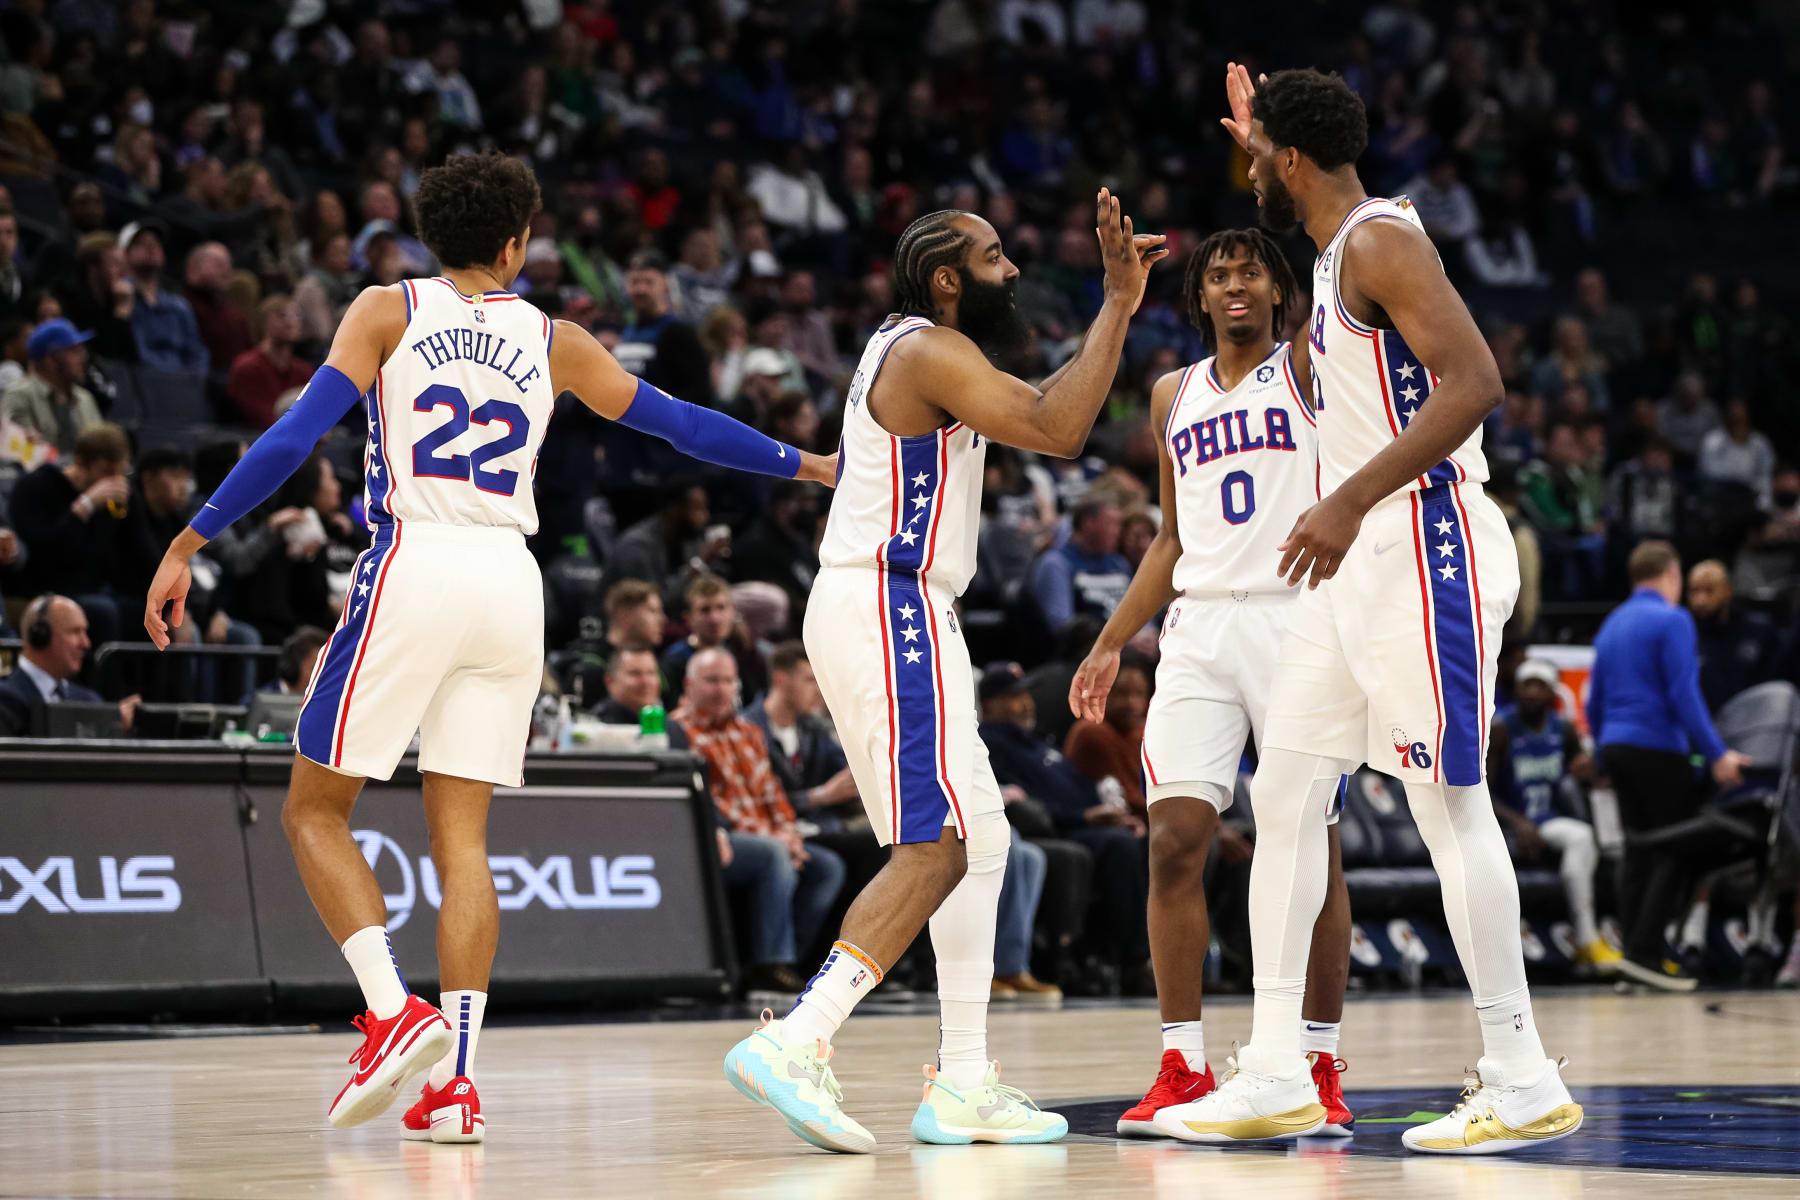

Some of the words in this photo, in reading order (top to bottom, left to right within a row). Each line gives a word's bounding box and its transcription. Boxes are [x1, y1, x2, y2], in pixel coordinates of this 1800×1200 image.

[412, 328, 541, 394] THYBULLE
[412, 384, 530, 497] 22
[1172, 407, 1297, 478] PHILA
[1221, 469, 1256, 526] 0
[1393, 741, 1433, 769] 76
[0, 855, 182, 914] XUS
